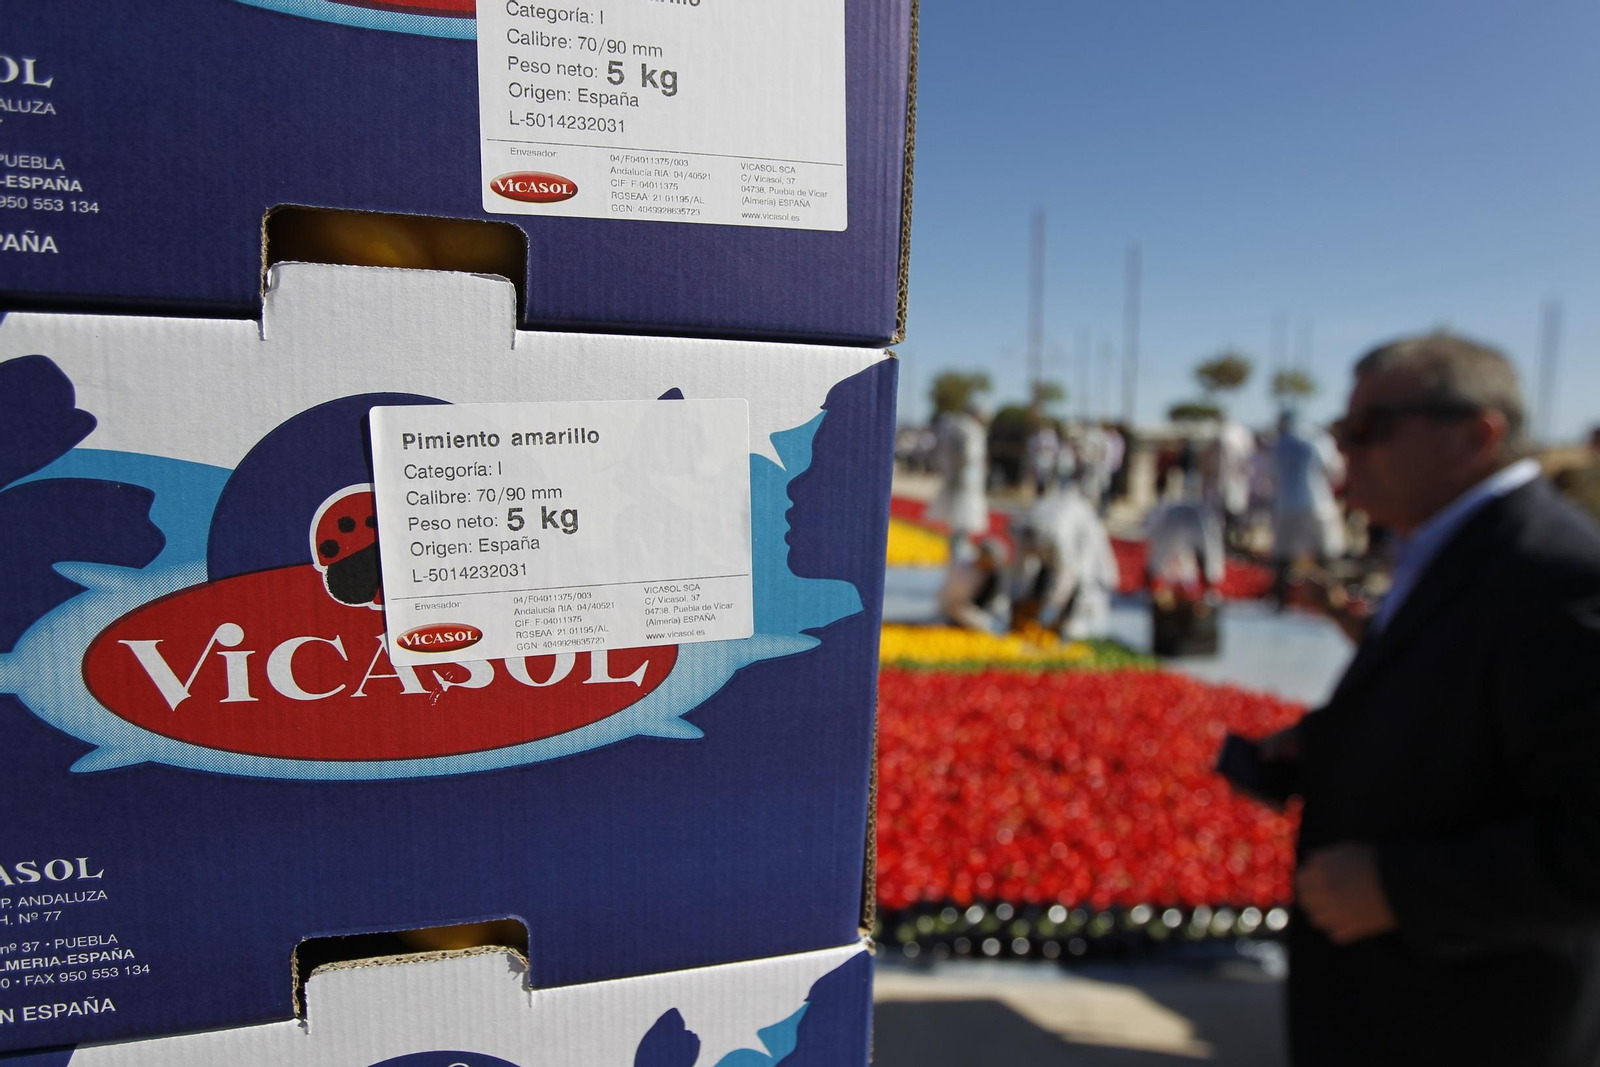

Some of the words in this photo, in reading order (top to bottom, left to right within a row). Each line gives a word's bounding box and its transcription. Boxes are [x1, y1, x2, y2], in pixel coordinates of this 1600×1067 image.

[505, 0, 595, 24] Categoría:
[506, 28, 573, 49] Calibre:
[577, 35, 627, 55] 70/90
[632, 43, 663, 57] mm
[507, 55, 551, 74] Peso
[556, 63, 599, 78] neto:
[606, 60, 625, 85] 5
[641, 63, 678, 97] kg
[508, 82, 571, 103] Origen:
[577, 87, 639, 108] España
[509, 110, 625, 133] L-5014232031
[610, 154, 689, 168] 04/F04011375/003
[740, 162, 777, 173] VICASOL
[779, 166, 796, 174] SCA
[610, 166, 652, 177] Andalucía
[673, 170, 711, 180] 04/40521
[741, 173, 752, 183] C/
[786, 177, 796, 185] 37
[769, 186, 795, 196] Puebla
[797, 187, 807, 196] de
[33, 197, 65, 212] 553
[70, 200, 100, 213] 134
[778, 197, 811, 208] ESPAÑA
[741, 211, 800, 222] www.vicasol.es
[402, 431, 501, 450] Pimiento
[511, 427, 600, 446] amarillo
[403, 461, 493, 481] Categoría:
[406, 490, 472, 506] Calibre:
[476, 486, 526, 505] 70/90
[531, 487, 563, 500] mm
[408, 516, 451, 532] Peso
[456, 515, 499, 529] neto:
[507, 507, 525, 532] 5
[540, 505, 579, 535] kg
[410, 540, 473, 559] Origen:
[478, 536, 540, 555] España
[412, 562, 528, 583] L-5014232031
[643, 585, 681, 594] VICASOL
[683, 583, 701, 592] SCA
[513, 591, 592, 605] 04/F04011375/003
[644, 597, 656, 606] C/
[690, 593, 701, 602] 37
[514, 605, 555, 616] Andalucía
[577, 601, 615, 612] 04/40521
[673, 603, 700, 614] Puebla
[702, 602, 712, 611] de
[535, 615, 583, 626] F-04011375
[683, 612, 717, 624] ESPAÑA
[557, 624, 609, 636] 21.01195/AL
[645, 628, 706, 640] www.vicasol.es
[516, 641, 540, 651] GGN:
[17, 889, 108, 908] ANDALUZA
[19, 911, 39, 924] Nº
[43, 911, 62, 922] 77
[22, 941, 40, 953] 37
[55, 934, 118, 949] PUEBLA
[25, 973, 55, 986] FAX
[59, 970, 87, 983] 950
[92, 967, 119, 980] 553
[125, 964, 151, 976] 134
[23, 995, 116, 1022] ESPAÑA
